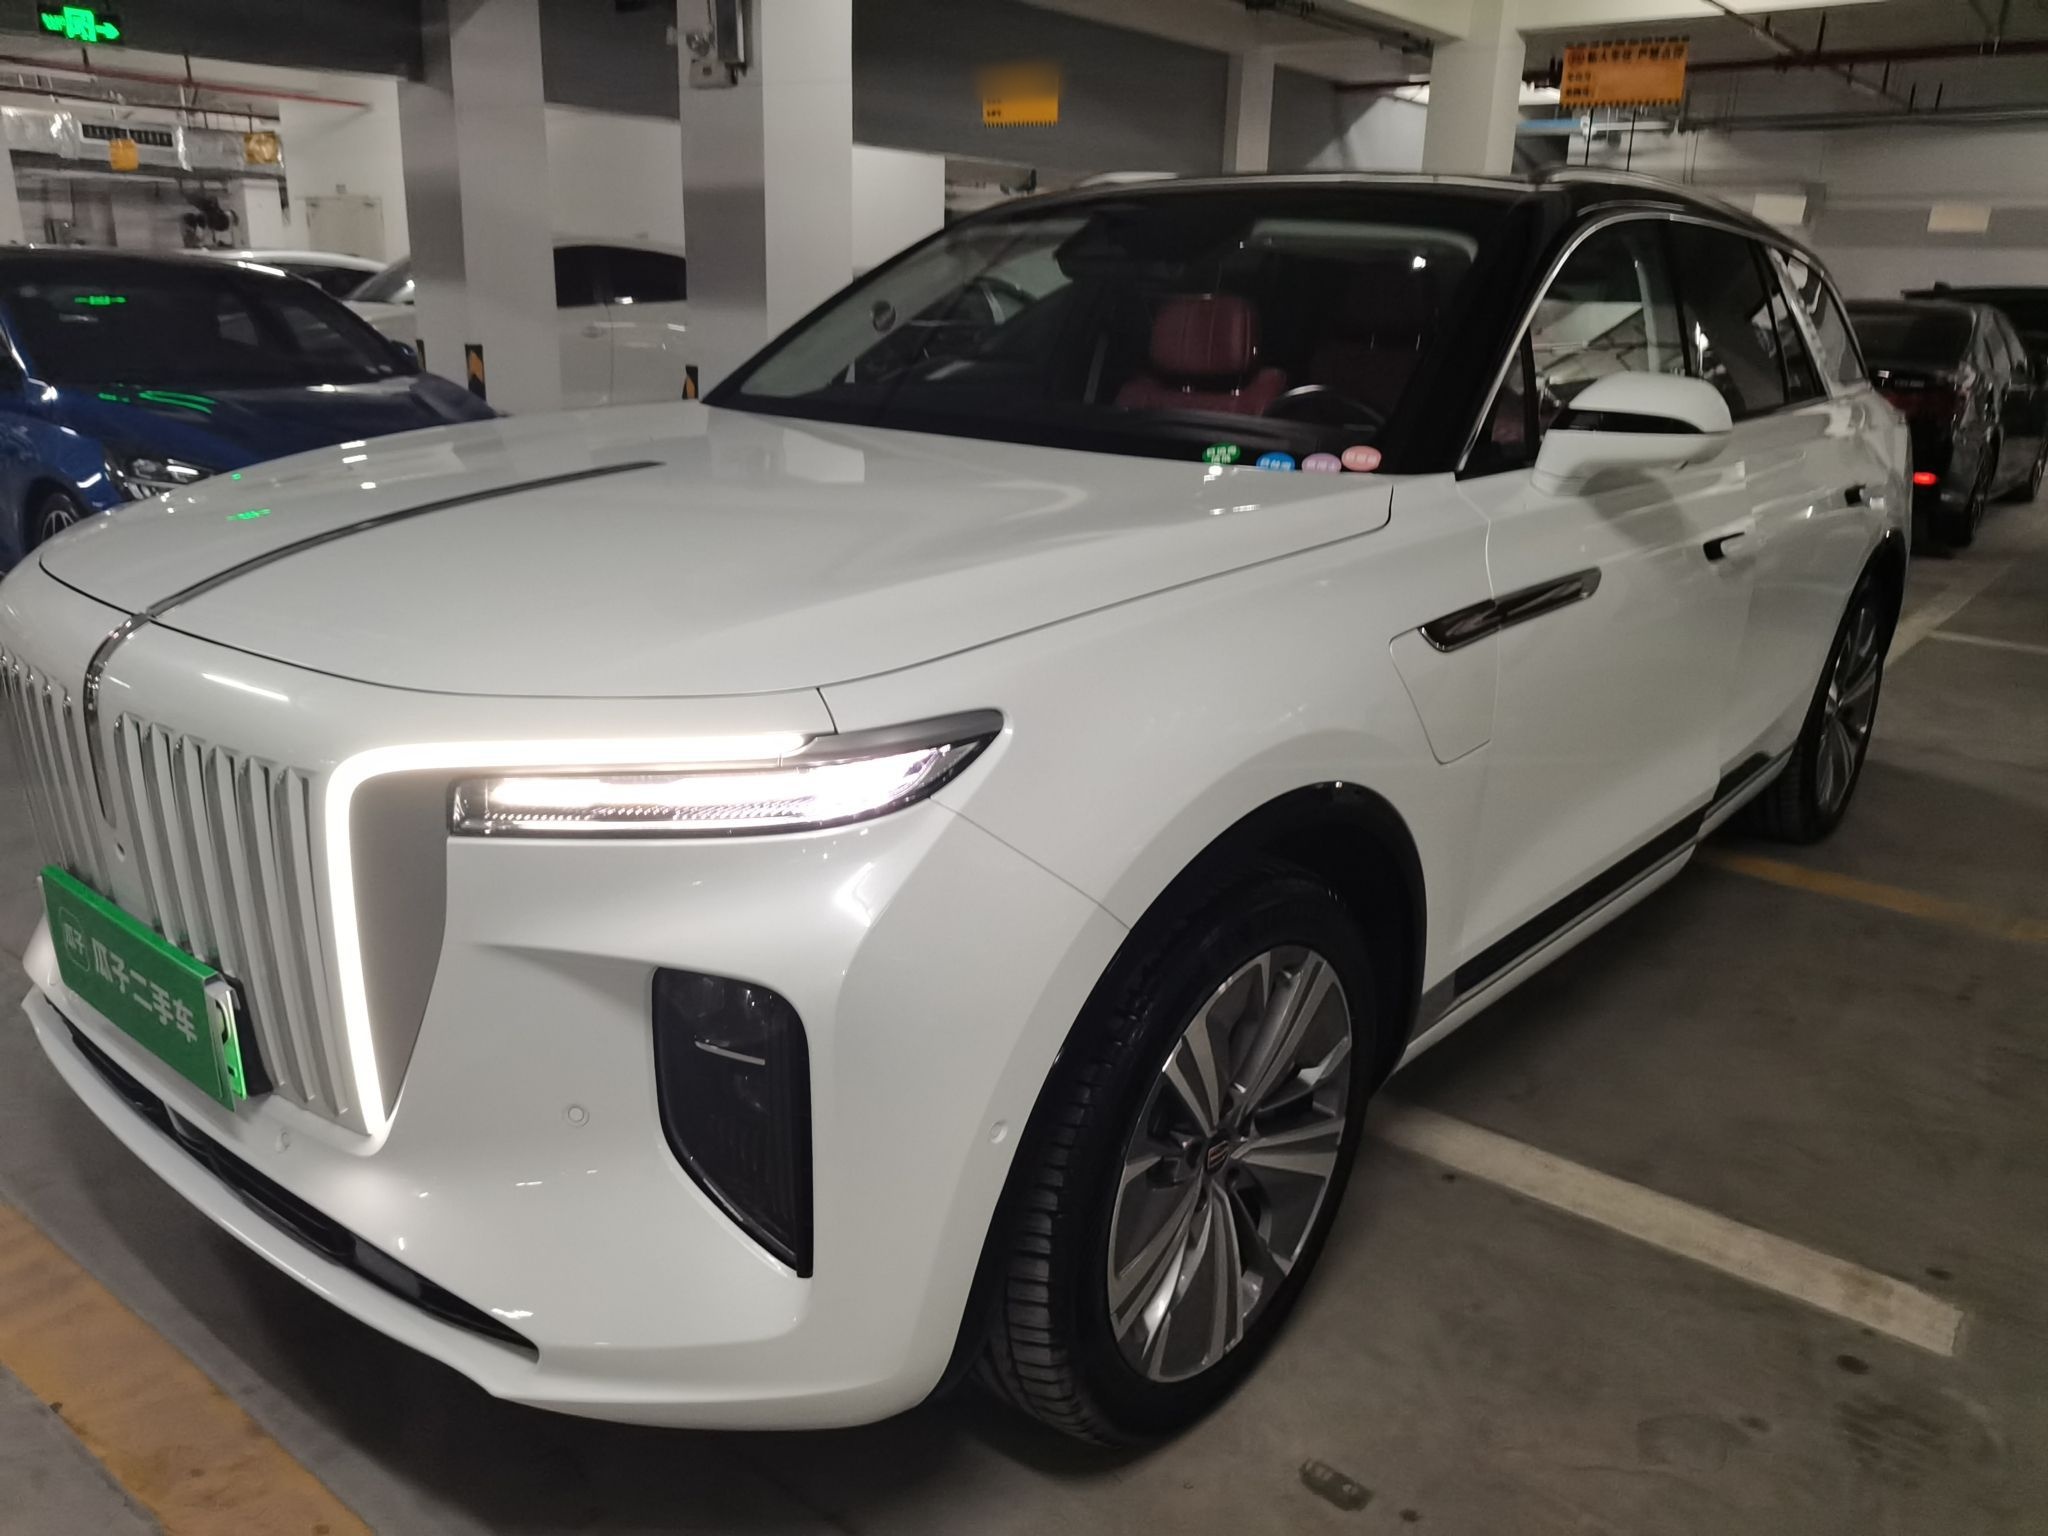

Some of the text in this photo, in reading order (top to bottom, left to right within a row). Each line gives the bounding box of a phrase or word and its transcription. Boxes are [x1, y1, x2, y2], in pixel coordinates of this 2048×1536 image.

[91, 936, 198, 1044] 瓜子二手车
